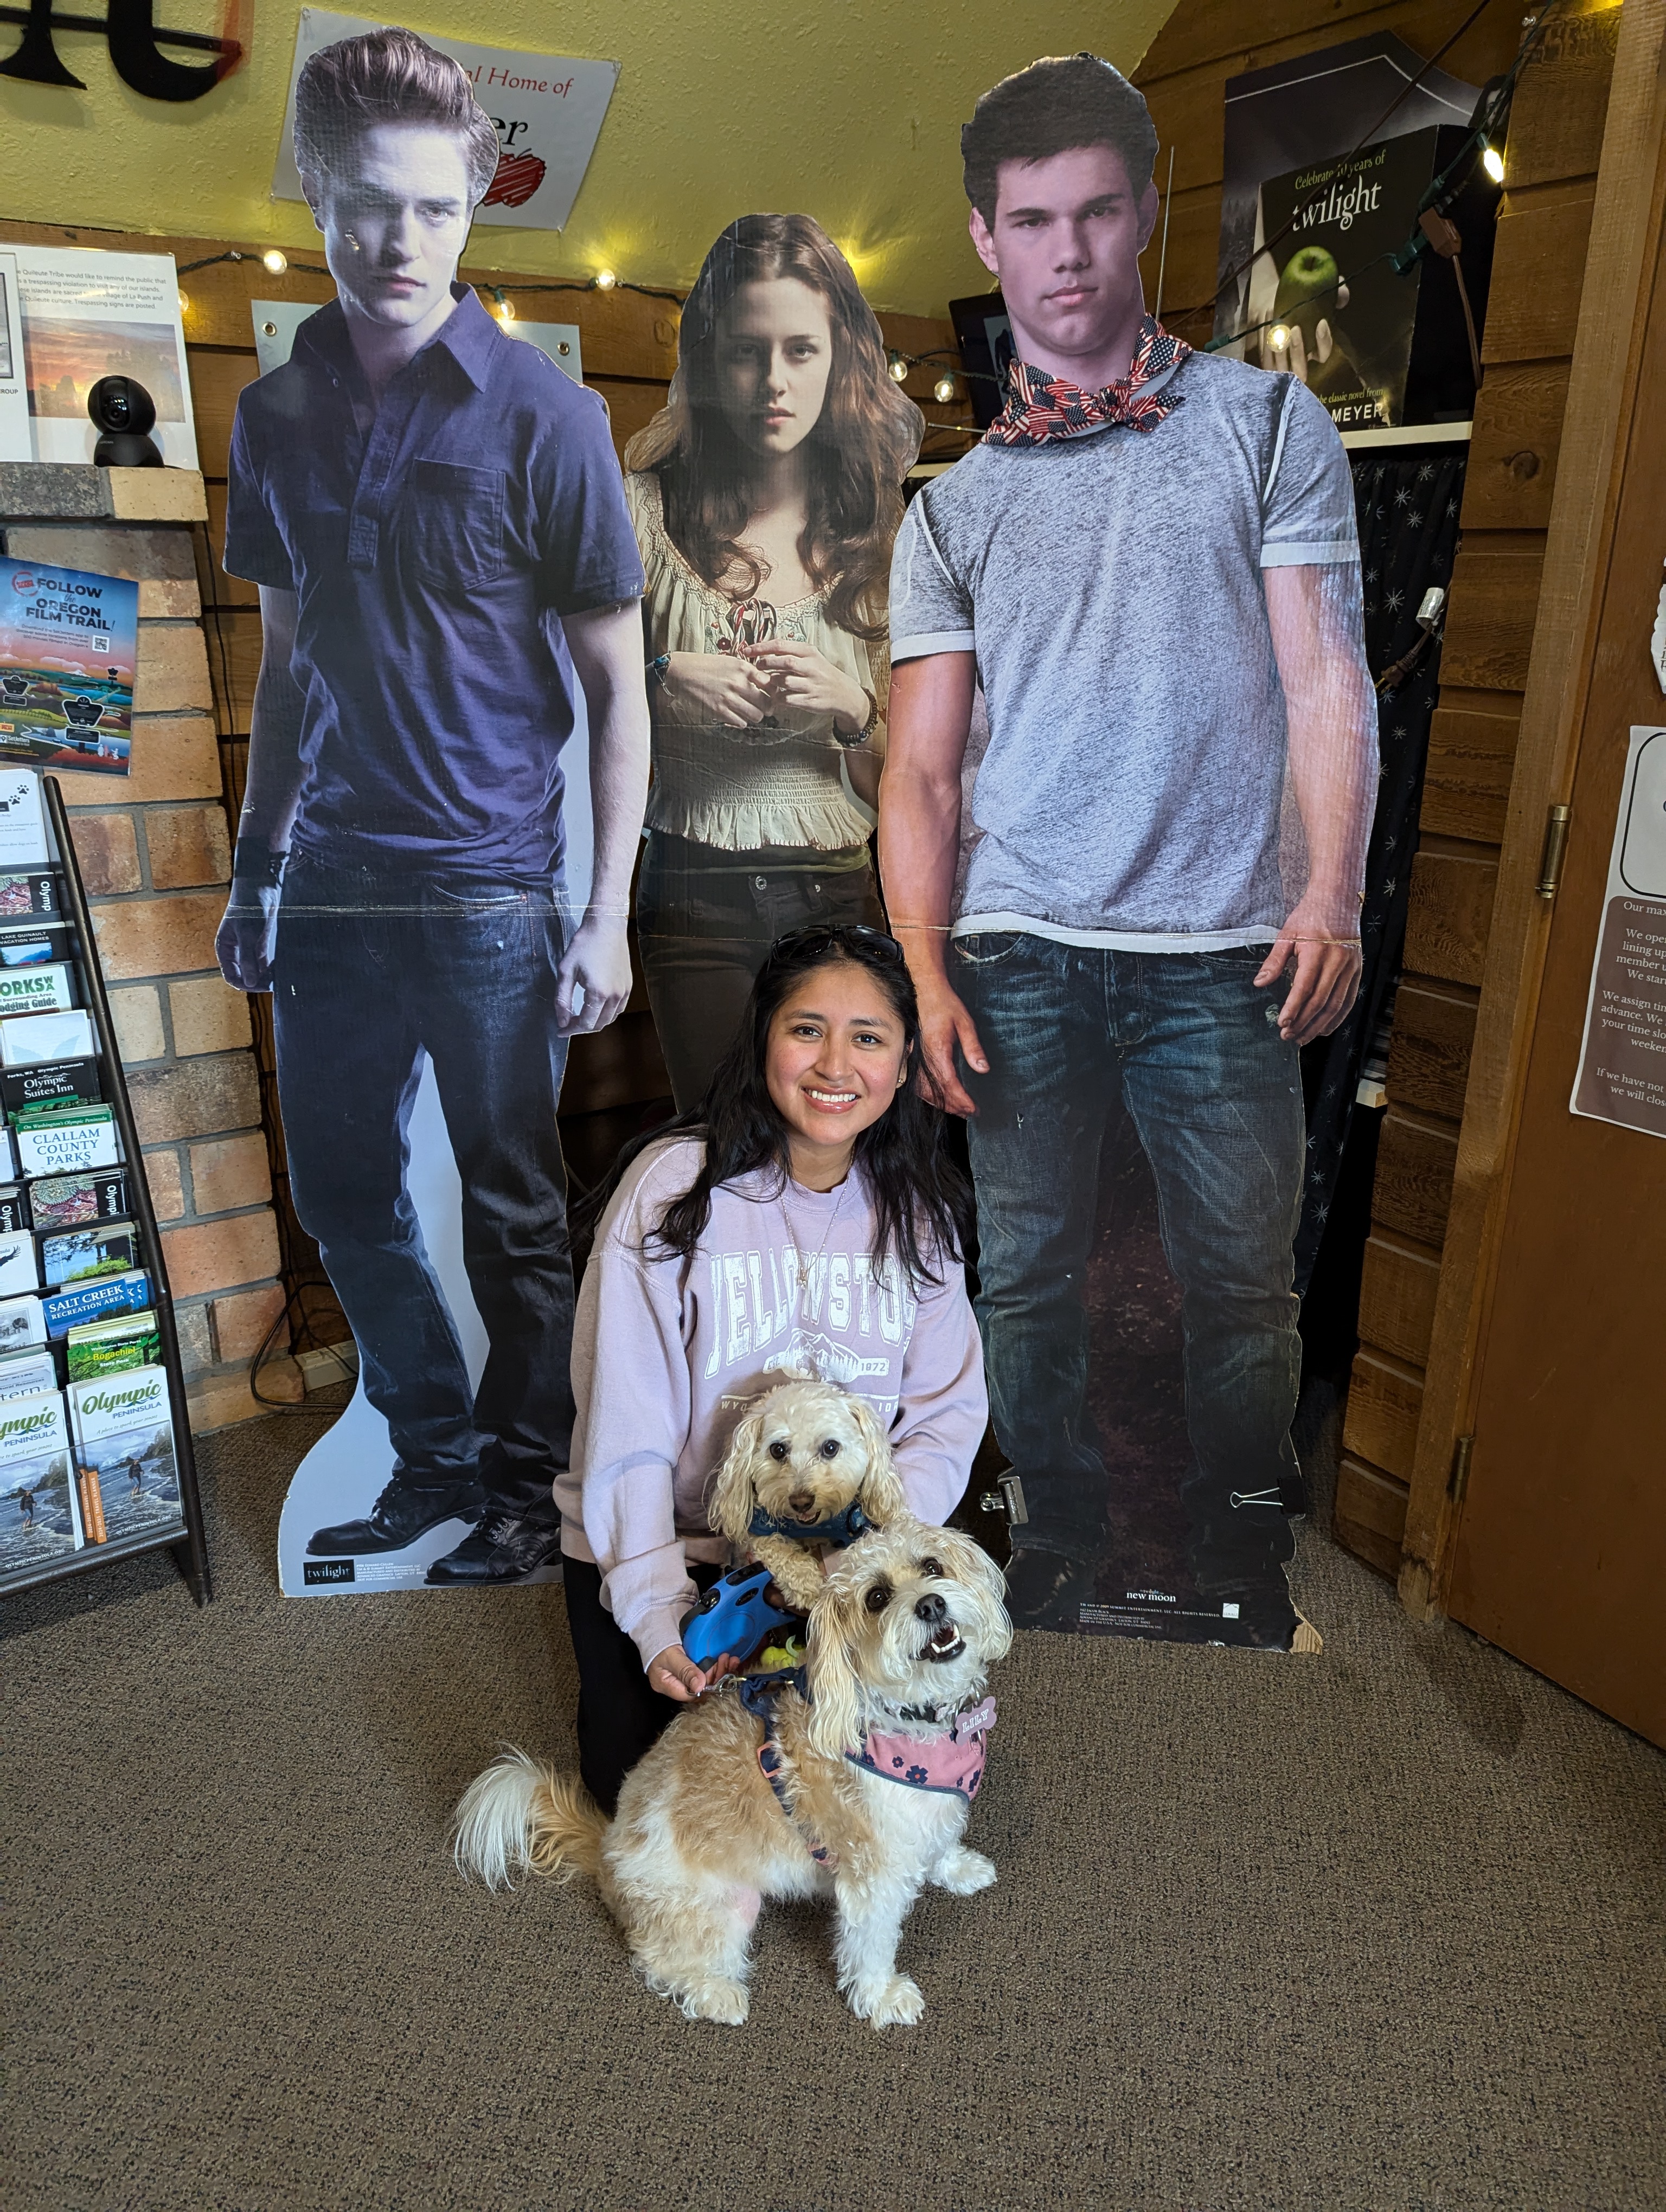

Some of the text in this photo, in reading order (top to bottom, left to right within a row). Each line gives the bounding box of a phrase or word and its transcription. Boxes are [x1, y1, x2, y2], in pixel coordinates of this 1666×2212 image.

[488, 67, 548, 92] Home
[553, 78, 574, 98] of
[1295, 170, 1334, 190] Celebrate
[1348, 159, 1373, 178] years
[1375, 149, 1386, 166] of
[1292, 175, 1382, 232] twilight
[29, 279, 62, 287] trespassing
[75, 299, 108, 307] Trespassing
[1329, 387, 1383, 403] classic novel from
[1332, 403, 1383, 423] MEYER
[36, 578, 103, 599] FOLLOW
[64, 594, 76, 603] the
[36, 597, 101, 618] OREGON
[26, 607, 116, 632] FILM TRAIL!
[39, 881, 52, 911] Olymp
[1624, 901, 1644, 912] Our
[1626, 928, 1643, 940] We
[1622, 941, 1653, 957] lining
[1616, 955, 1660, 970] member
[1627, 969, 1644, 980] We
[3, 994, 39, 1002] Surrounding
[31, 997, 57, 1008] Guide
[1602, 990, 1619, 1002] We
[1621, 997, 1651, 1009] assign
[1601, 1005, 1663, 1025] advance. We
[1601, 1018, 1626, 1030] your
[1627, 1023, 1651, 1036] time
[24, 1076, 68, 1089] Olympic
[1597, 1067, 1664, 1093] If we have not
[24, 1084, 74, 1099] Suites Inn
[1611, 1086, 1625, 1095] we
[1626, 1090, 1644, 1101] will
[33, 1121, 64, 1129] Washington's
[33, 1128, 100, 1145] CLALLAM
[37, 1139, 99, 1155] COUNTY
[46, 1151, 92, 1166] PARKS
[48, 1296, 80, 1313] SALT
[82, 1284, 124, 1303] CREEK
[52, 1301, 102, 1320] RECREATION
[104, 1295, 125, 1305] AREA
[93, 1346, 136, 1361] Bogachiel
[861, 1362, 886, 1372] 1872
[82, 1379, 162, 1415] Olympic
[112, 1401, 162, 1419] PENINSULA
[101, 1426, 113, 1435] place
[119, 1420, 132, 1429] spark
[4, 1430, 57, 1448] PENINSULA
[11, 1449, 25, 1458] spark
[116, 1515, 172, 1535] OLYMPICPENINSULA.ORG
[5, 1548, 65, 1568] OLYMPICPENINSULA.ORG
[307, 1564, 350, 1579] twilight
[1126, 1592, 1176, 1603] new moon
[962, 1708, 989, 1733] LILY
